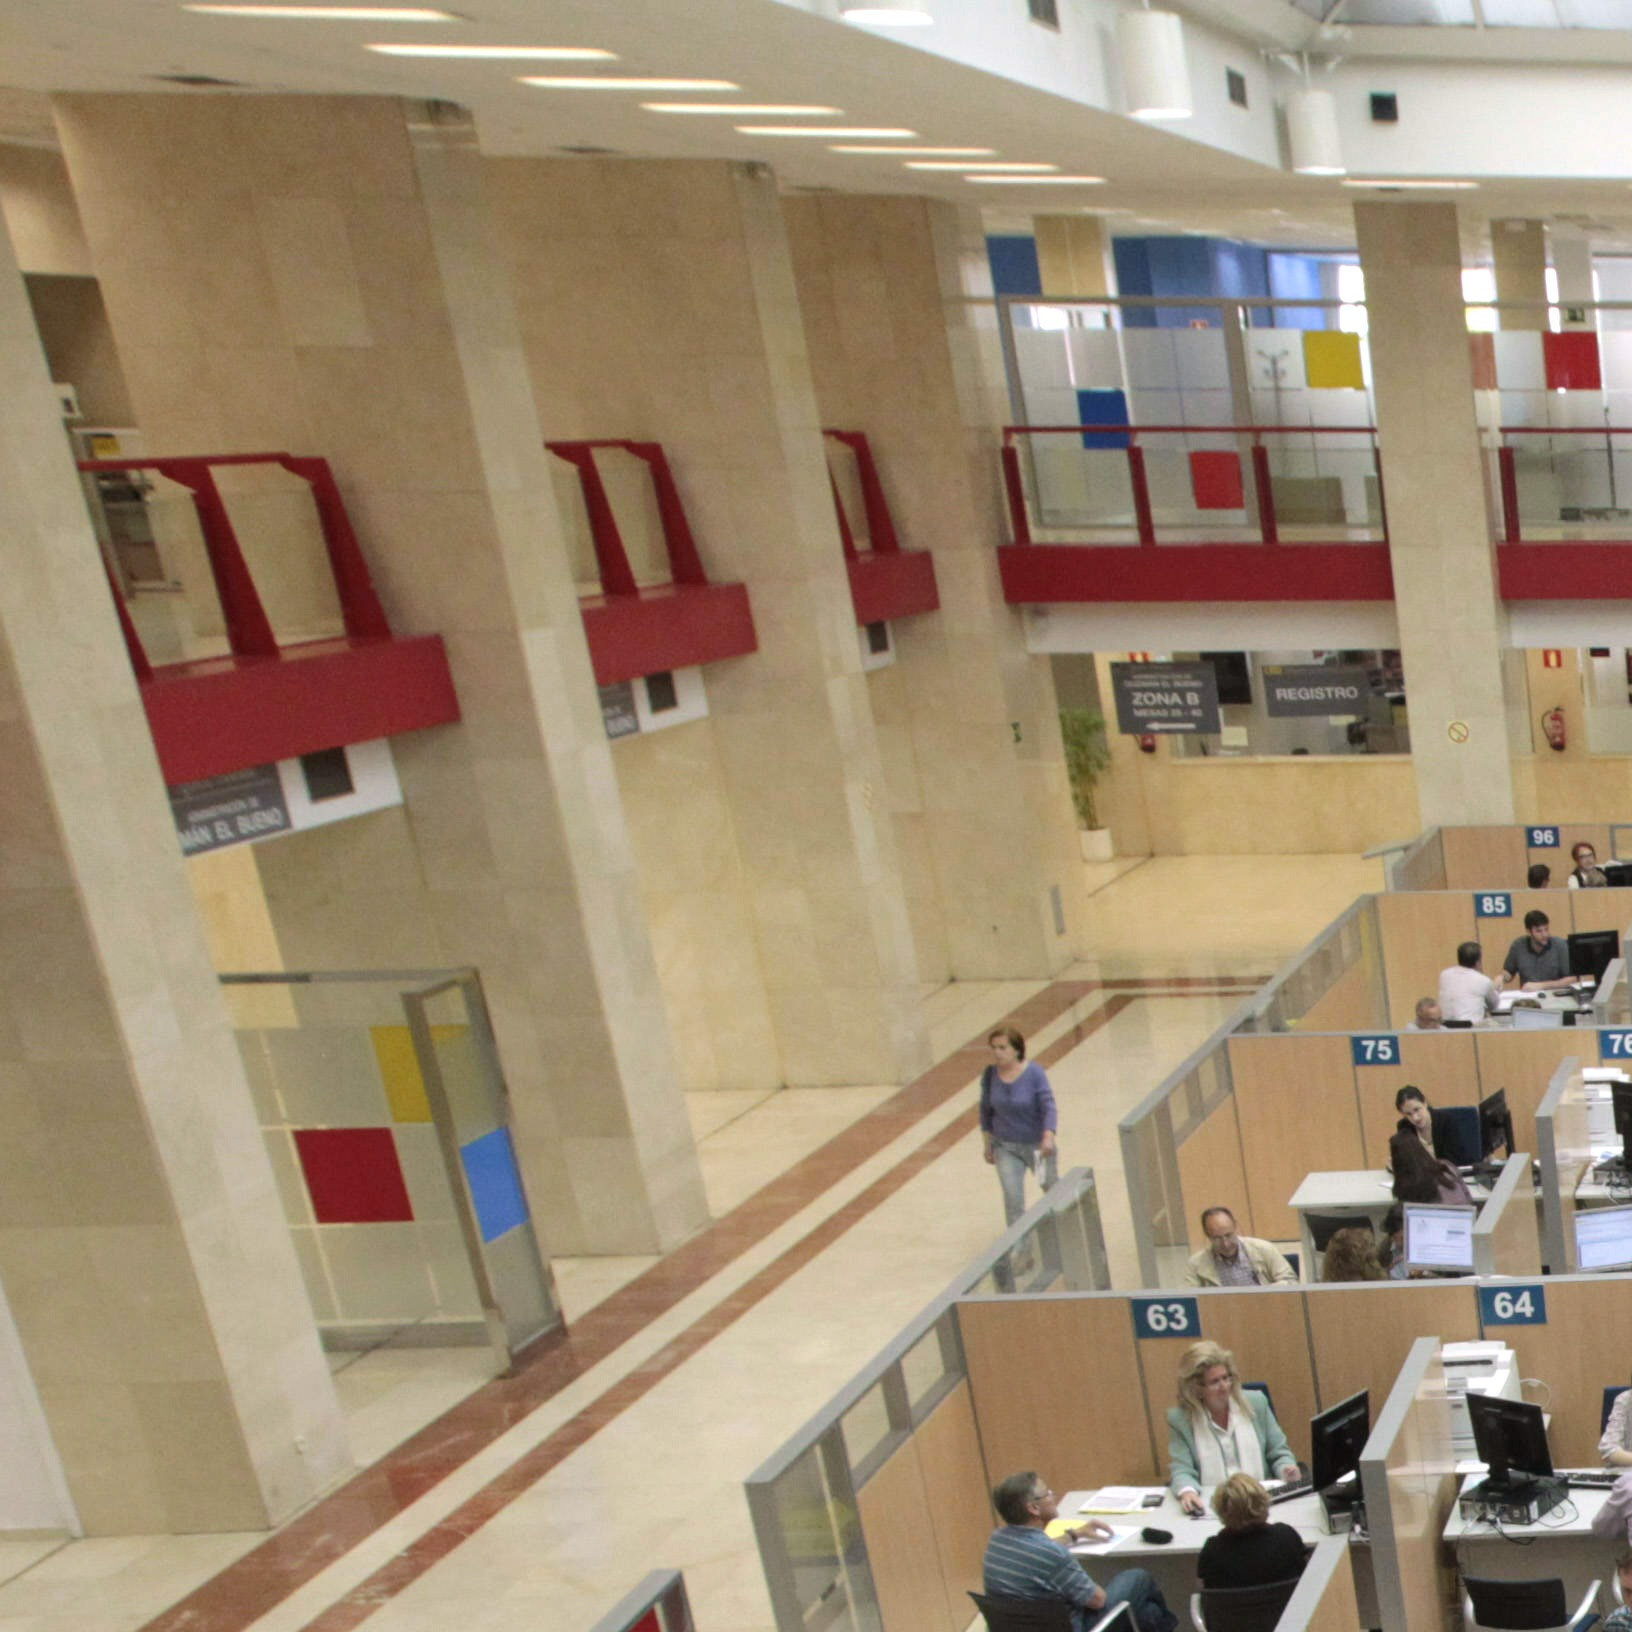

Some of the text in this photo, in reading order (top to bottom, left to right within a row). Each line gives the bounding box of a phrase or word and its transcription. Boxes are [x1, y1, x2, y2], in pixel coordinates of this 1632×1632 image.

[1131, 691, 1200, 706] ZONA B
[1275, 685, 1359, 702] REGISTRO
[1532, 829, 1555, 846] 96
[1481, 894, 1507, 915] 85
[1360, 1038, 1394, 1062] 75
[1492, 1289, 1536, 1320] 64
[1145, 1302, 1189, 1333] 63
